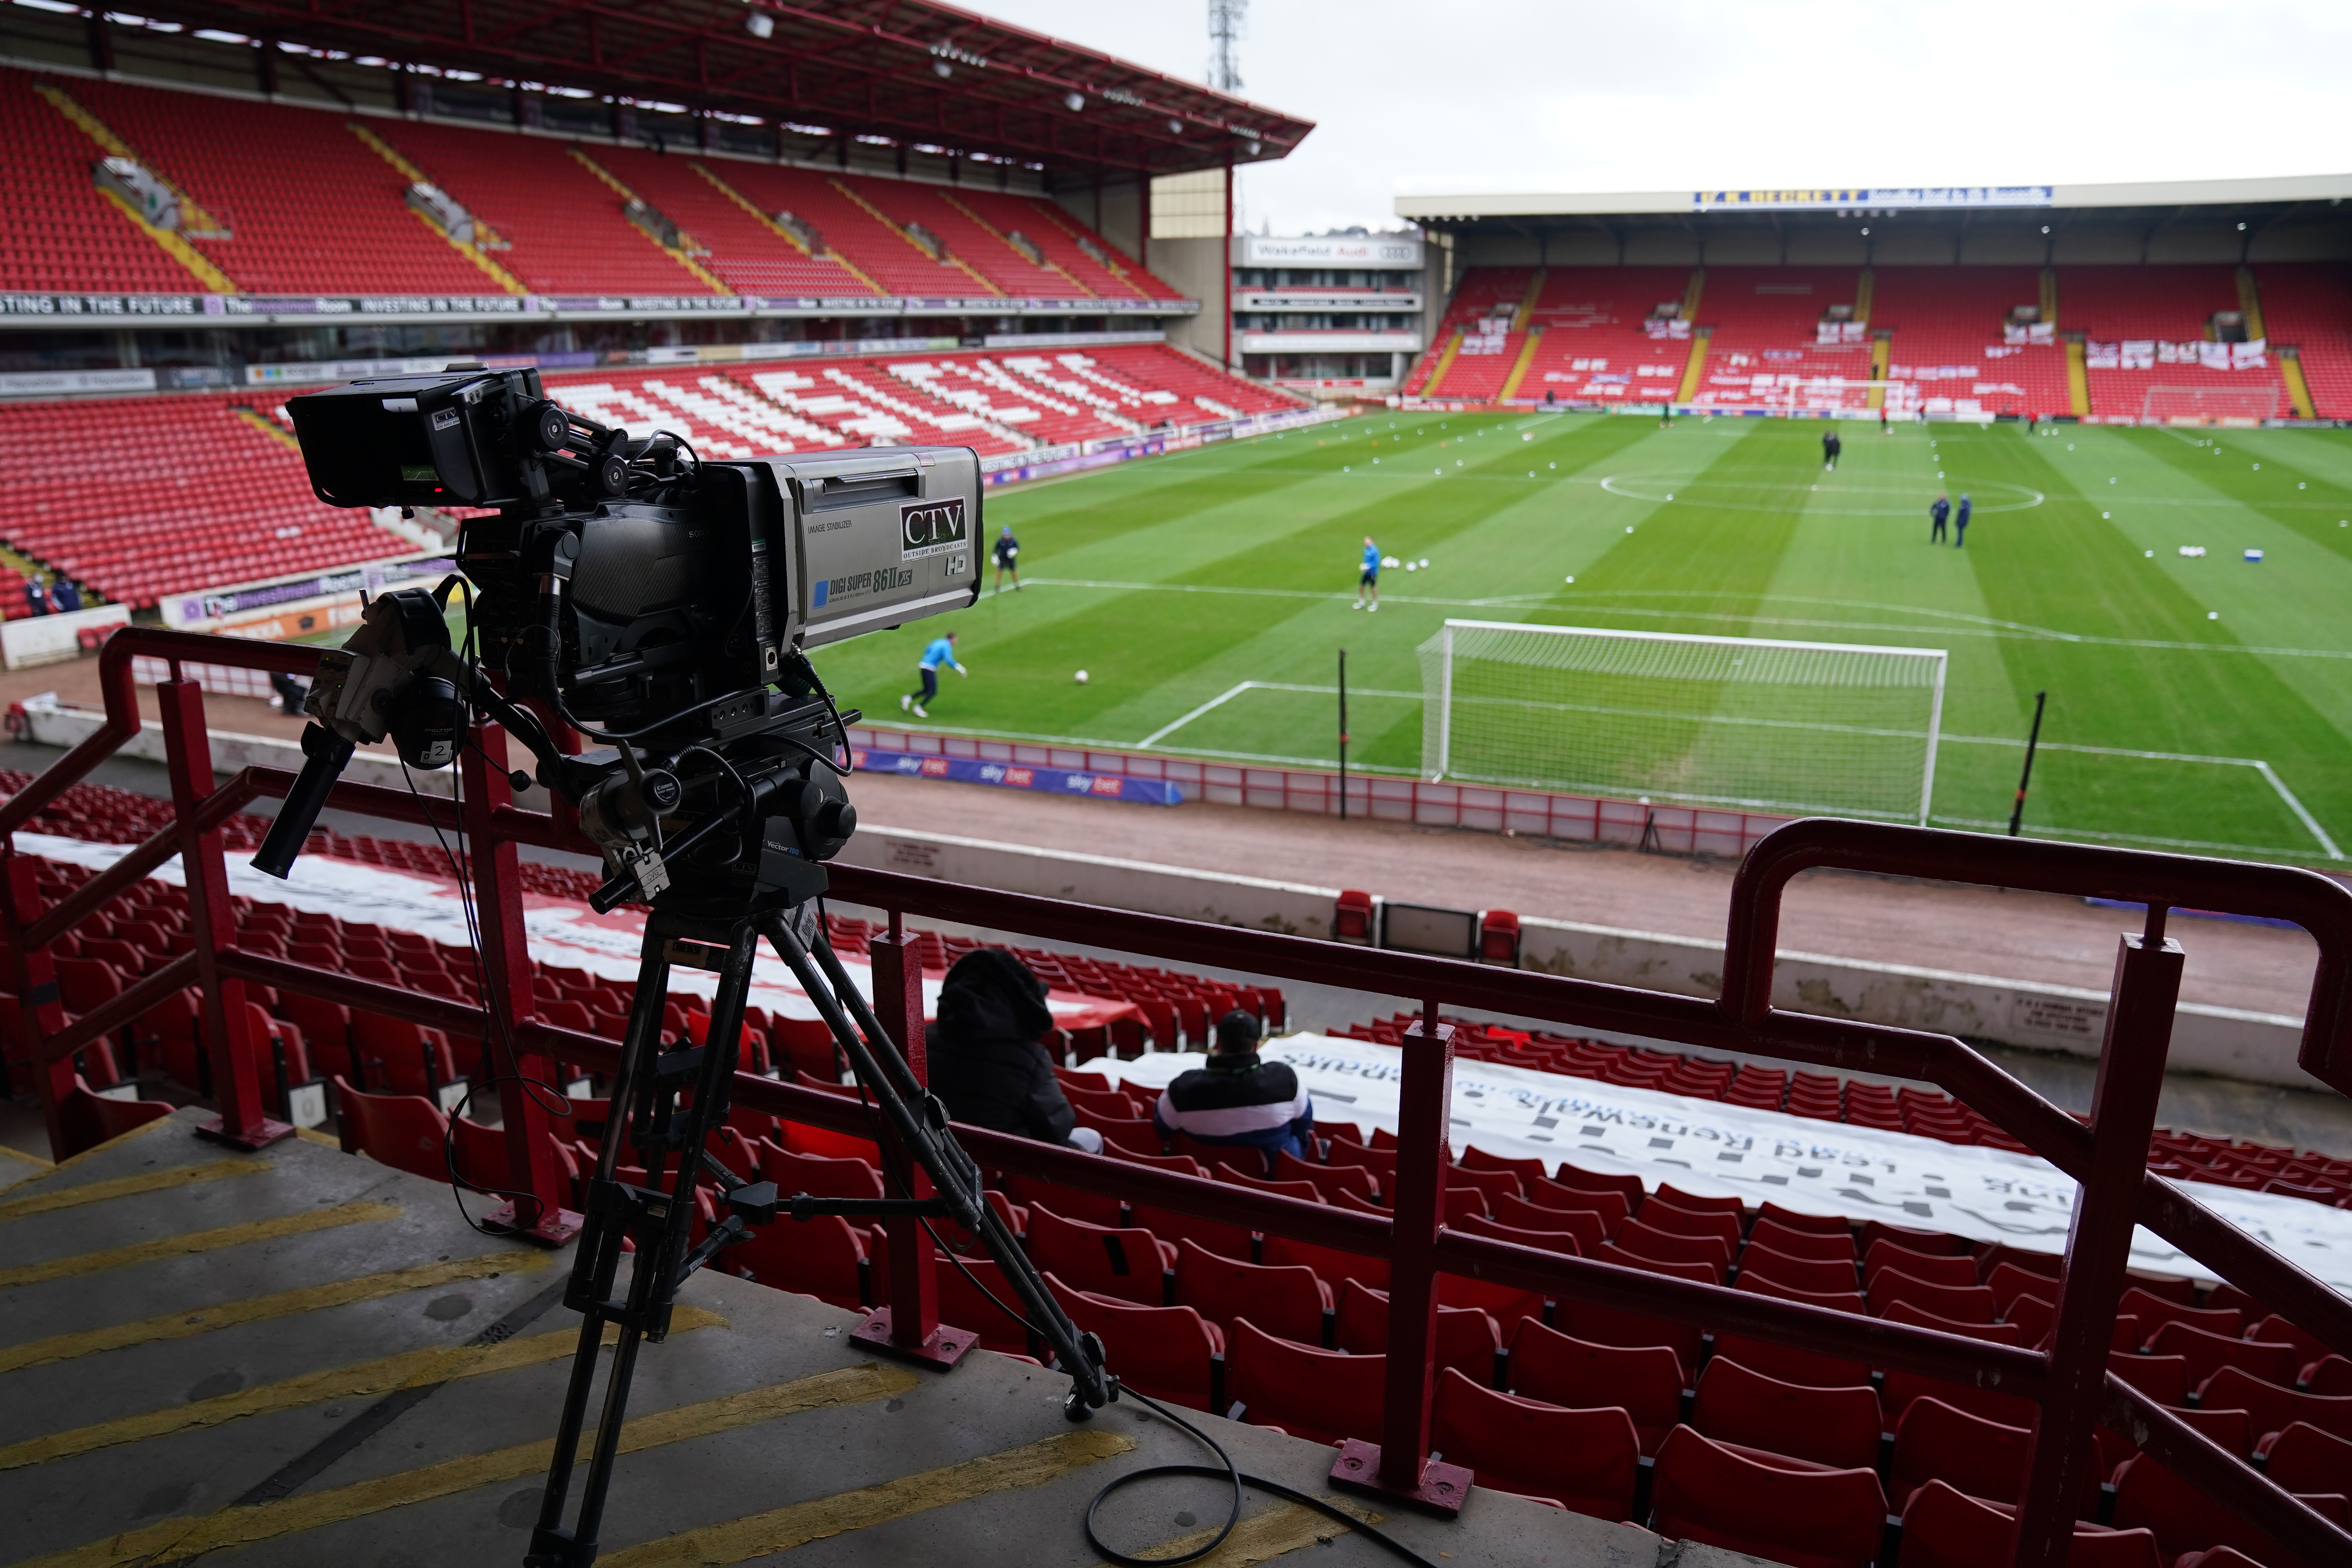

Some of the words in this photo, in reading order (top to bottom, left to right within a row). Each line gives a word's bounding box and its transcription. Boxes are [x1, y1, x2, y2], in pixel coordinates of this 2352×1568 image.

[1338, 245, 1368, 257] Audi
[59, 296, 82, 314] IN
[89, 296, 123, 314] THE
[128, 296, 196, 314] FUTURE
[360, 296, 430, 312] INVESTING
[450, 296, 473, 312] THE
[475, 296, 520, 312] FUTURE
[436, 410, 456, 422] CTV
[808, 524, 826, 534] IMAGE
[826, 520, 852, 531] STABILIZER
[905, 505, 962, 544] CTV
[903, 548, 929, 559] OUTSIDE
[931, 543, 966, 554] BROADCASTS
[946, 555, 967, 576] HD
[829, 577, 846, 595] DIGI
[847, 572, 872, 592] SUPER
[898, 570, 911, 586] XS
[205, 595, 238, 618] The
[236, 580, 320, 610] Investment
[318, 571, 364, 593] Room
[435, 746, 446, 756] 2
[898, 756, 923, 773] sky
[924, 759, 947, 775] bet
[981, 765, 1005, 783] sky
[1006, 768, 1033, 784] bet
[657, 782, 673, 791] Canon
[1067, 773, 1093, 793] sky
[1093, 777, 1120, 794] bet
[767, 840, 789, 852] Vector
[789, 847, 799, 855] 700
[647, 869, 659, 881] CVG
[801, 914, 815, 940] Vinten
[674, 943, 700, 953] CTV
[1517, 1098, 1755, 1152] Renewals
[1774, 1142, 1896, 1175] Lead
